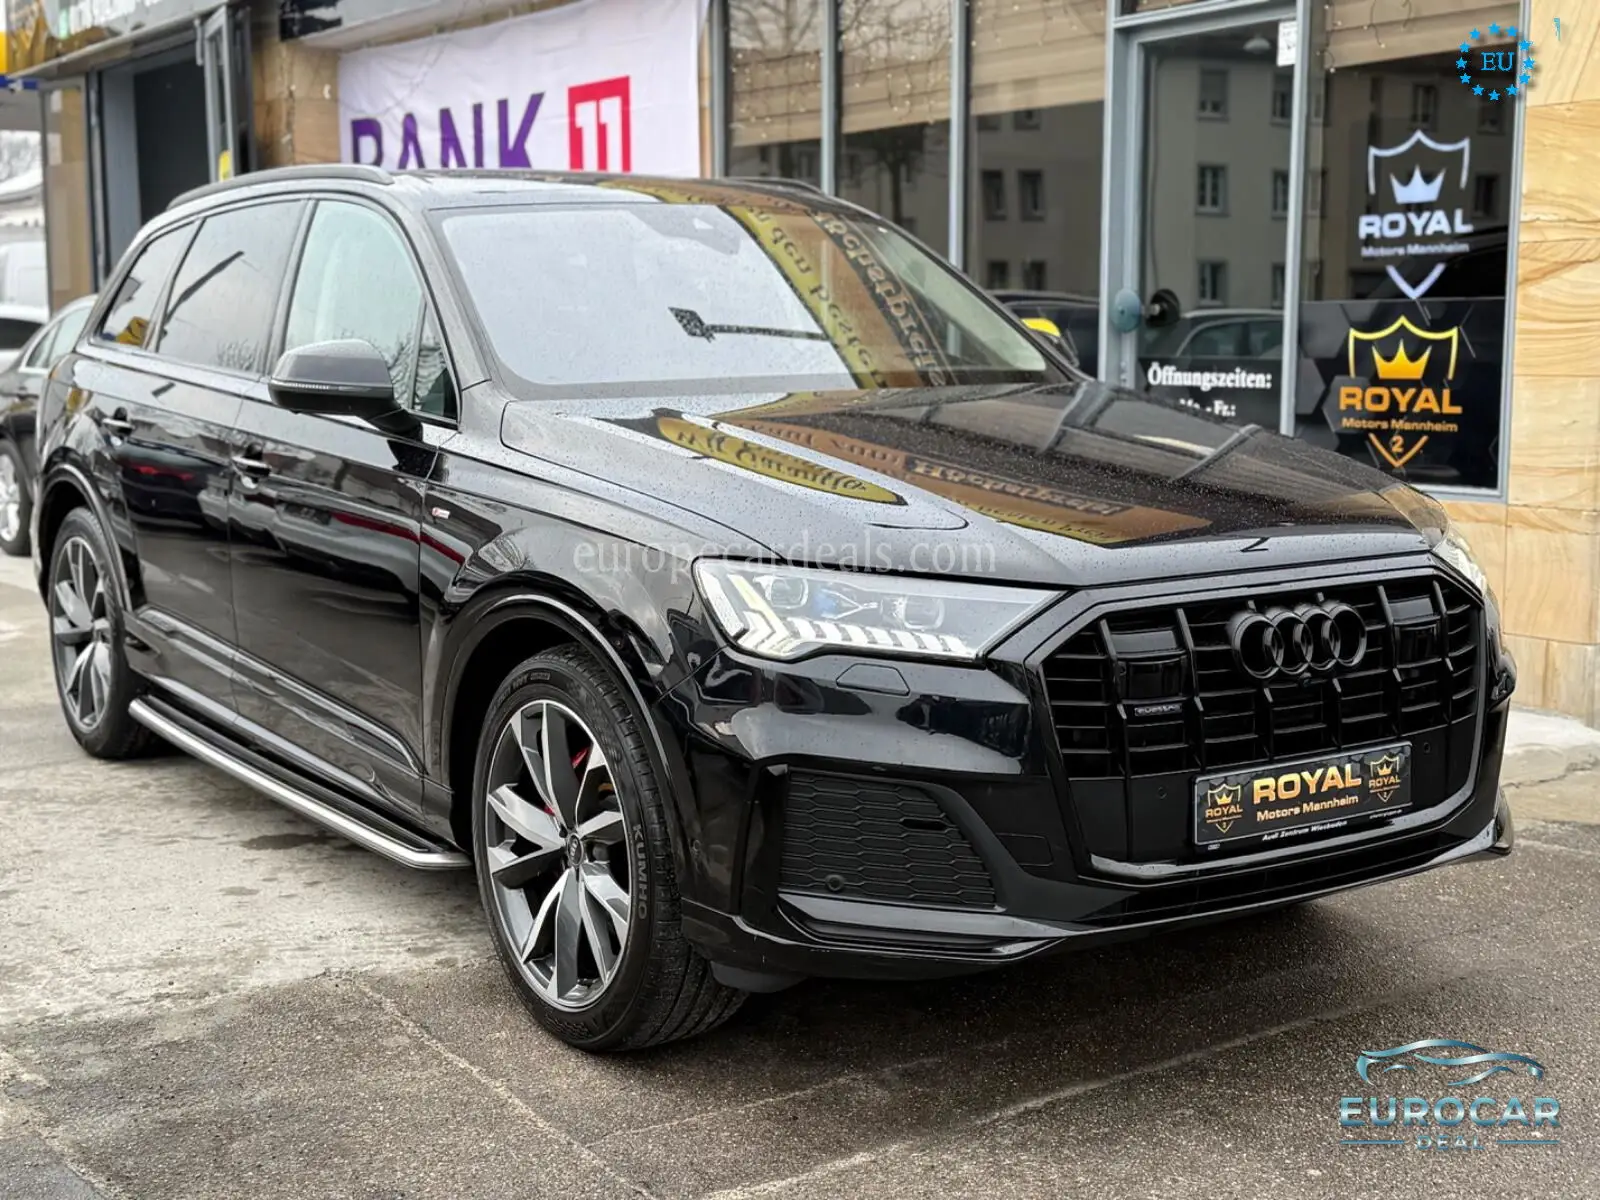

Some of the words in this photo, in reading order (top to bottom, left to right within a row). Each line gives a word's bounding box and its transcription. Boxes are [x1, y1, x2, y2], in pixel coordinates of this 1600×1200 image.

[1358, 208, 1474, 240] ROYAL
[1361, 245, 1405, 257] Motors
[1407, 242, 1470, 255] Mannheim
[1147, 361, 1273, 392] Öffnungszeiten:
[1339, 386, 1463, 414] ROYAL
[1341, 417, 1389, 430] Motors
[1390, 418, 1458, 432] Mannheim
[1391, 435, 1405, 453] 2
[1253, 763, 1362, 805] ROYAL
[1368, 775, 1401, 790] ROYAL
[1205, 804, 1243, 818] ROYAL
[1256, 805, 1300, 822] Motors
[1302, 794, 1359, 814] Mannheim
[632, 823, 648, 921] KUMHO
